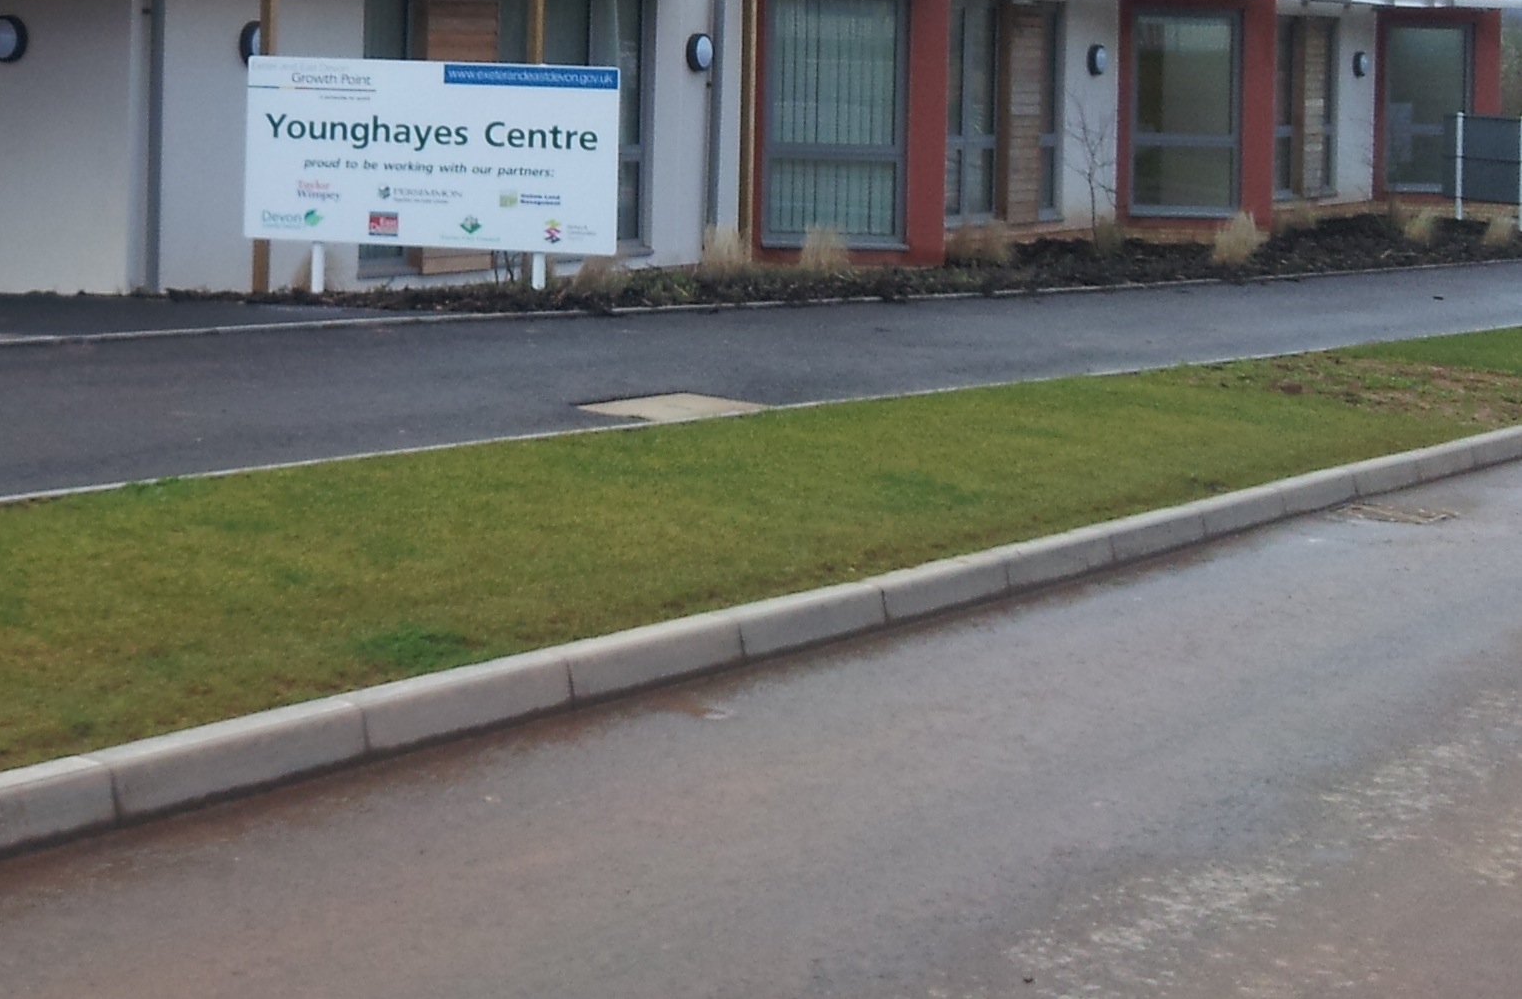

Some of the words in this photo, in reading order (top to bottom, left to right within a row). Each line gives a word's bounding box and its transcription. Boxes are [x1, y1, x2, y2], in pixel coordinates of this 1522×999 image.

[291, 71, 337, 85] Growth
[341, 73, 371, 86] Point
[265, 112, 469, 152] Younghayes
[484, 120, 599, 151] Centre
[303, 157, 341, 170] proud
[345, 159, 358, 169] to
[363, 159, 377, 170] be
[383, 161, 434, 174] working
[439, 162, 467, 174] with
[471, 166, 492, 175] our
[496, 165, 556, 178] partners:
[296, 189, 340, 201] Wimpey
[262, 209, 302, 222] Devon
